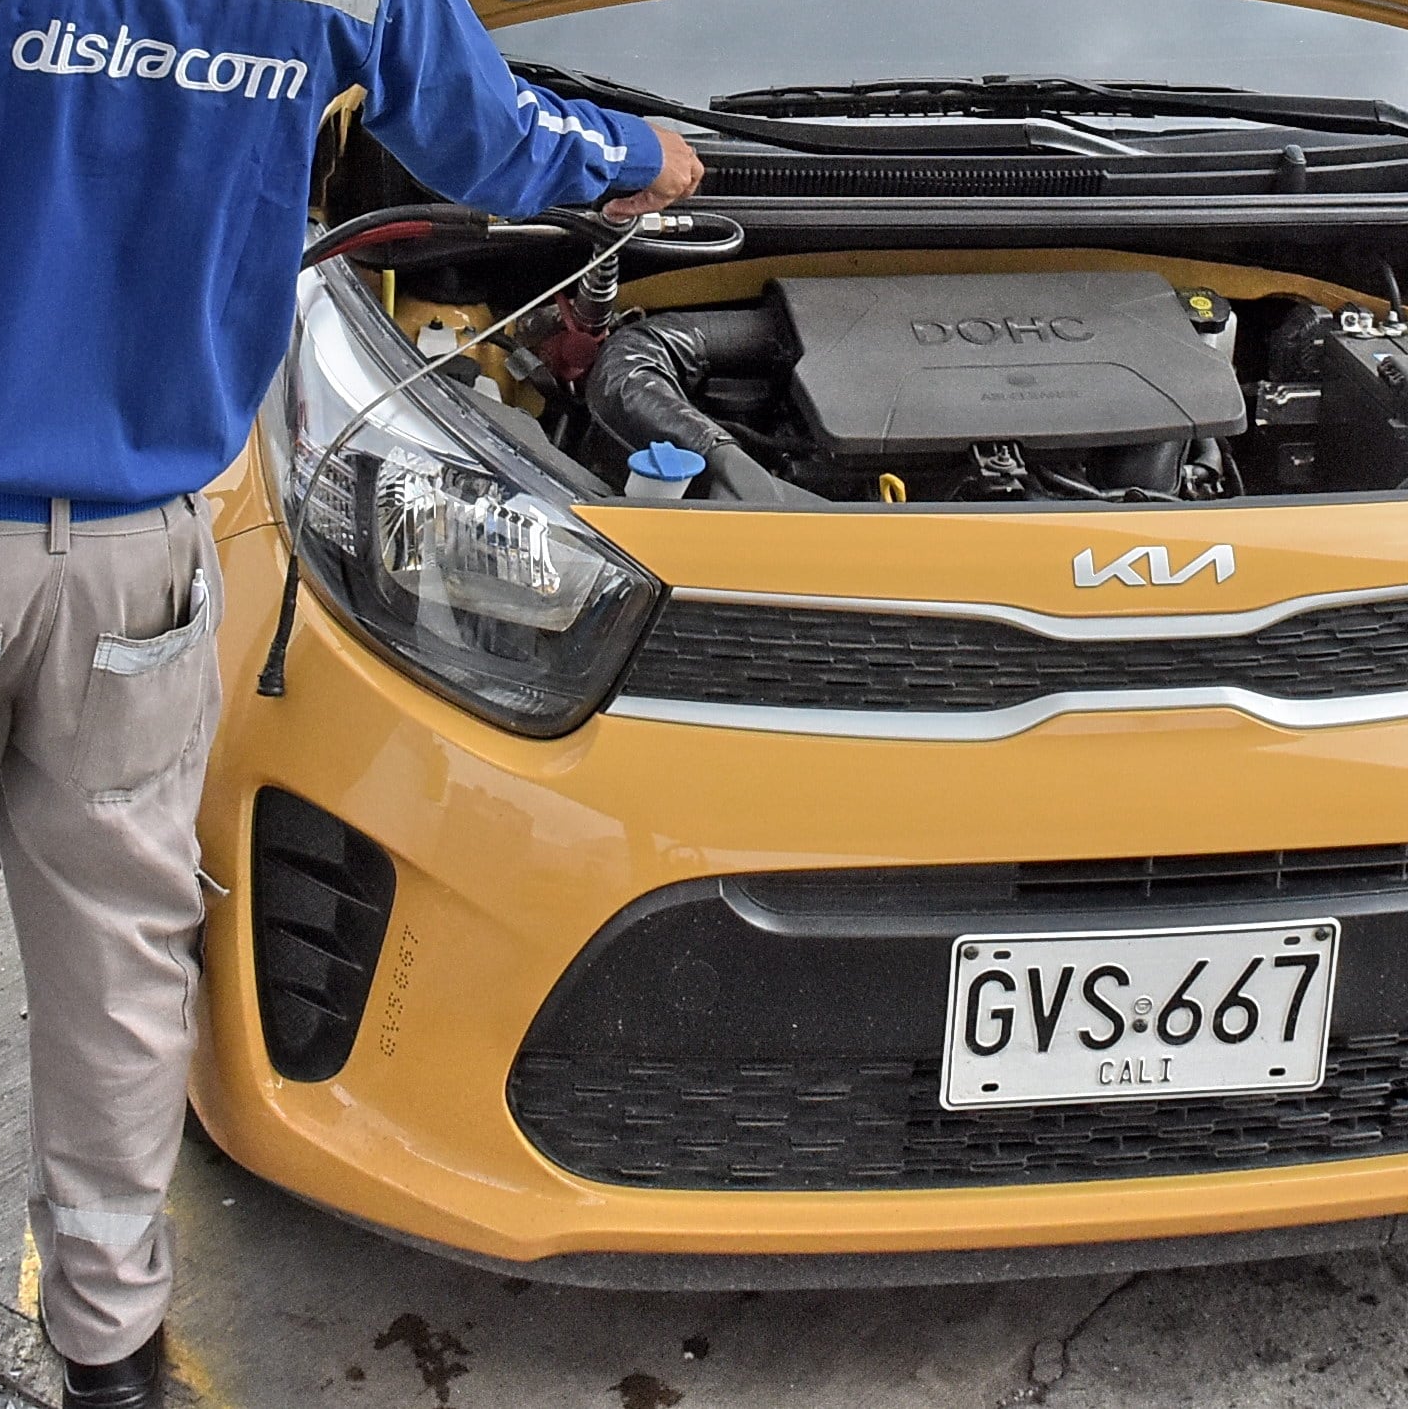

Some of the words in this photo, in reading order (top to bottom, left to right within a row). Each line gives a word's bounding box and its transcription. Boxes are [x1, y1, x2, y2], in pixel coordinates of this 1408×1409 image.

[11, 19, 308, 100] distacom
[910, 315, 1096, 346] DOHC
[1072, 544, 1236, 588] KIA
[963, 963, 1132, 1058] GVS
[1155, 954, 1322, 1048] 667
[1098, 1056, 1173, 1086] CALI
